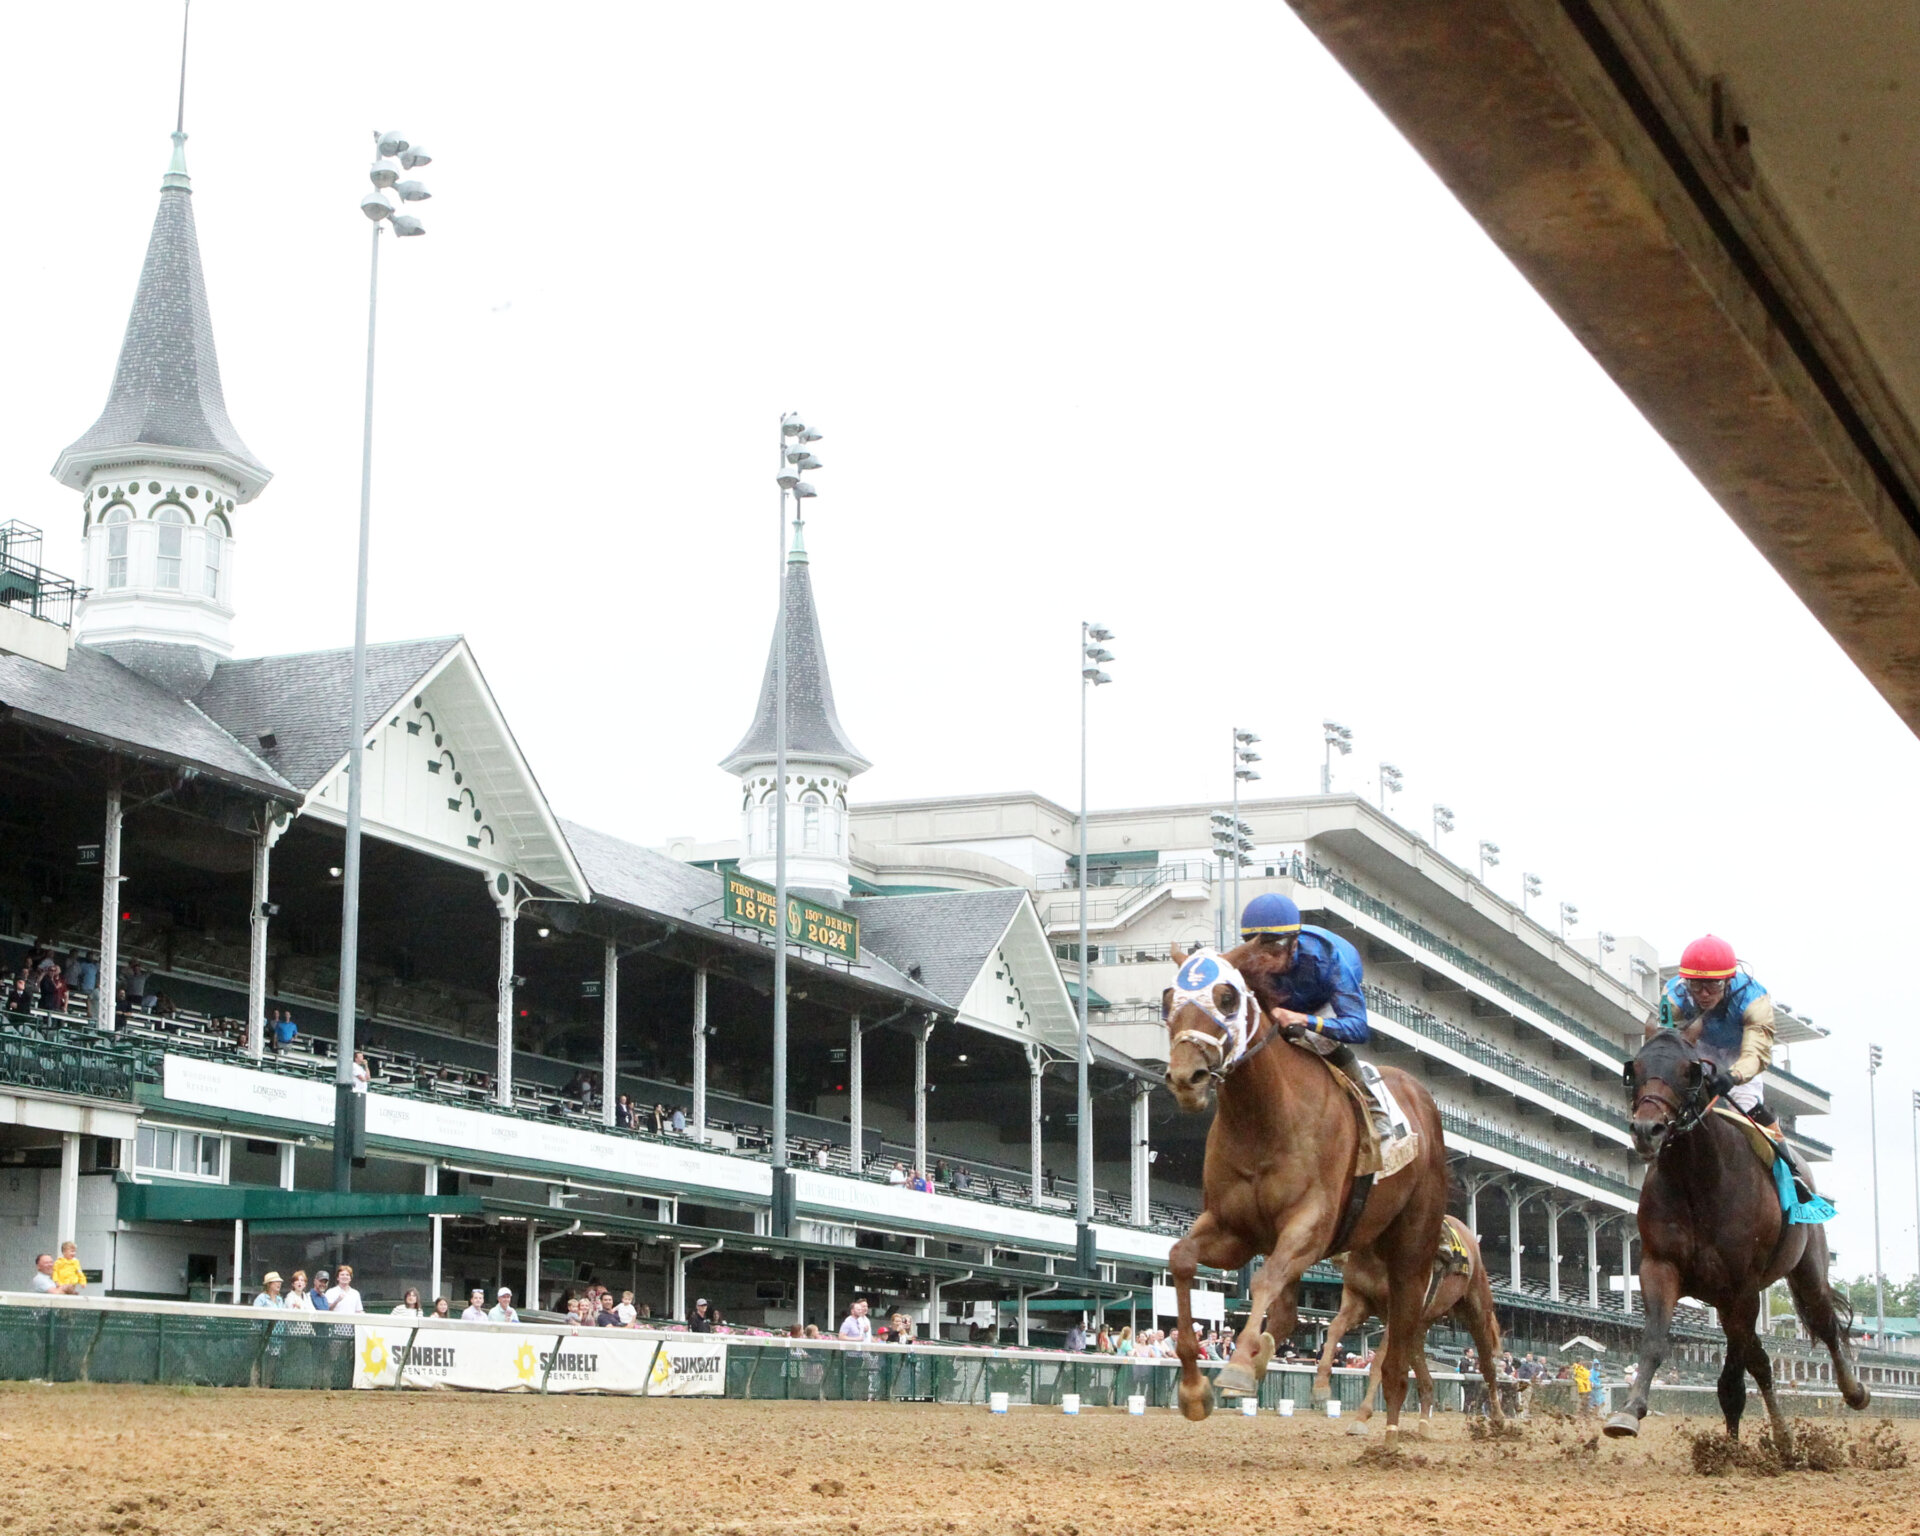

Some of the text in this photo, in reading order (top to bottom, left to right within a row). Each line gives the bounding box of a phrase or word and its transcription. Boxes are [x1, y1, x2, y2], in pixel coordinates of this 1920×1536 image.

[81, 850, 95, 859] 318
[730, 881, 777, 907] FIRST DERB
[735, 897, 777, 927] 1875
[825, 916, 853, 934] DERBY
[808, 924, 847, 951] 2024
[1662, 1004, 1669, 1024] 9
[253, 1084, 287, 1098] LONGINES
[379, 1108, 410, 1120] LONGINES
[797, 1176, 847, 1202] CHURCHILL
[849, 1184, 880, 1207] DOWNS
[391, 1345, 455, 1367] SUNBELT
[540, 1352, 598, 1372] SUNBELT
[673, 1356, 721, 1374] SUNBELT
[402, 1367, 447, 1377] RENTALS
[548, 1372, 590, 1381] RENTALS
[680, 1374, 713, 1382] RENTALS
